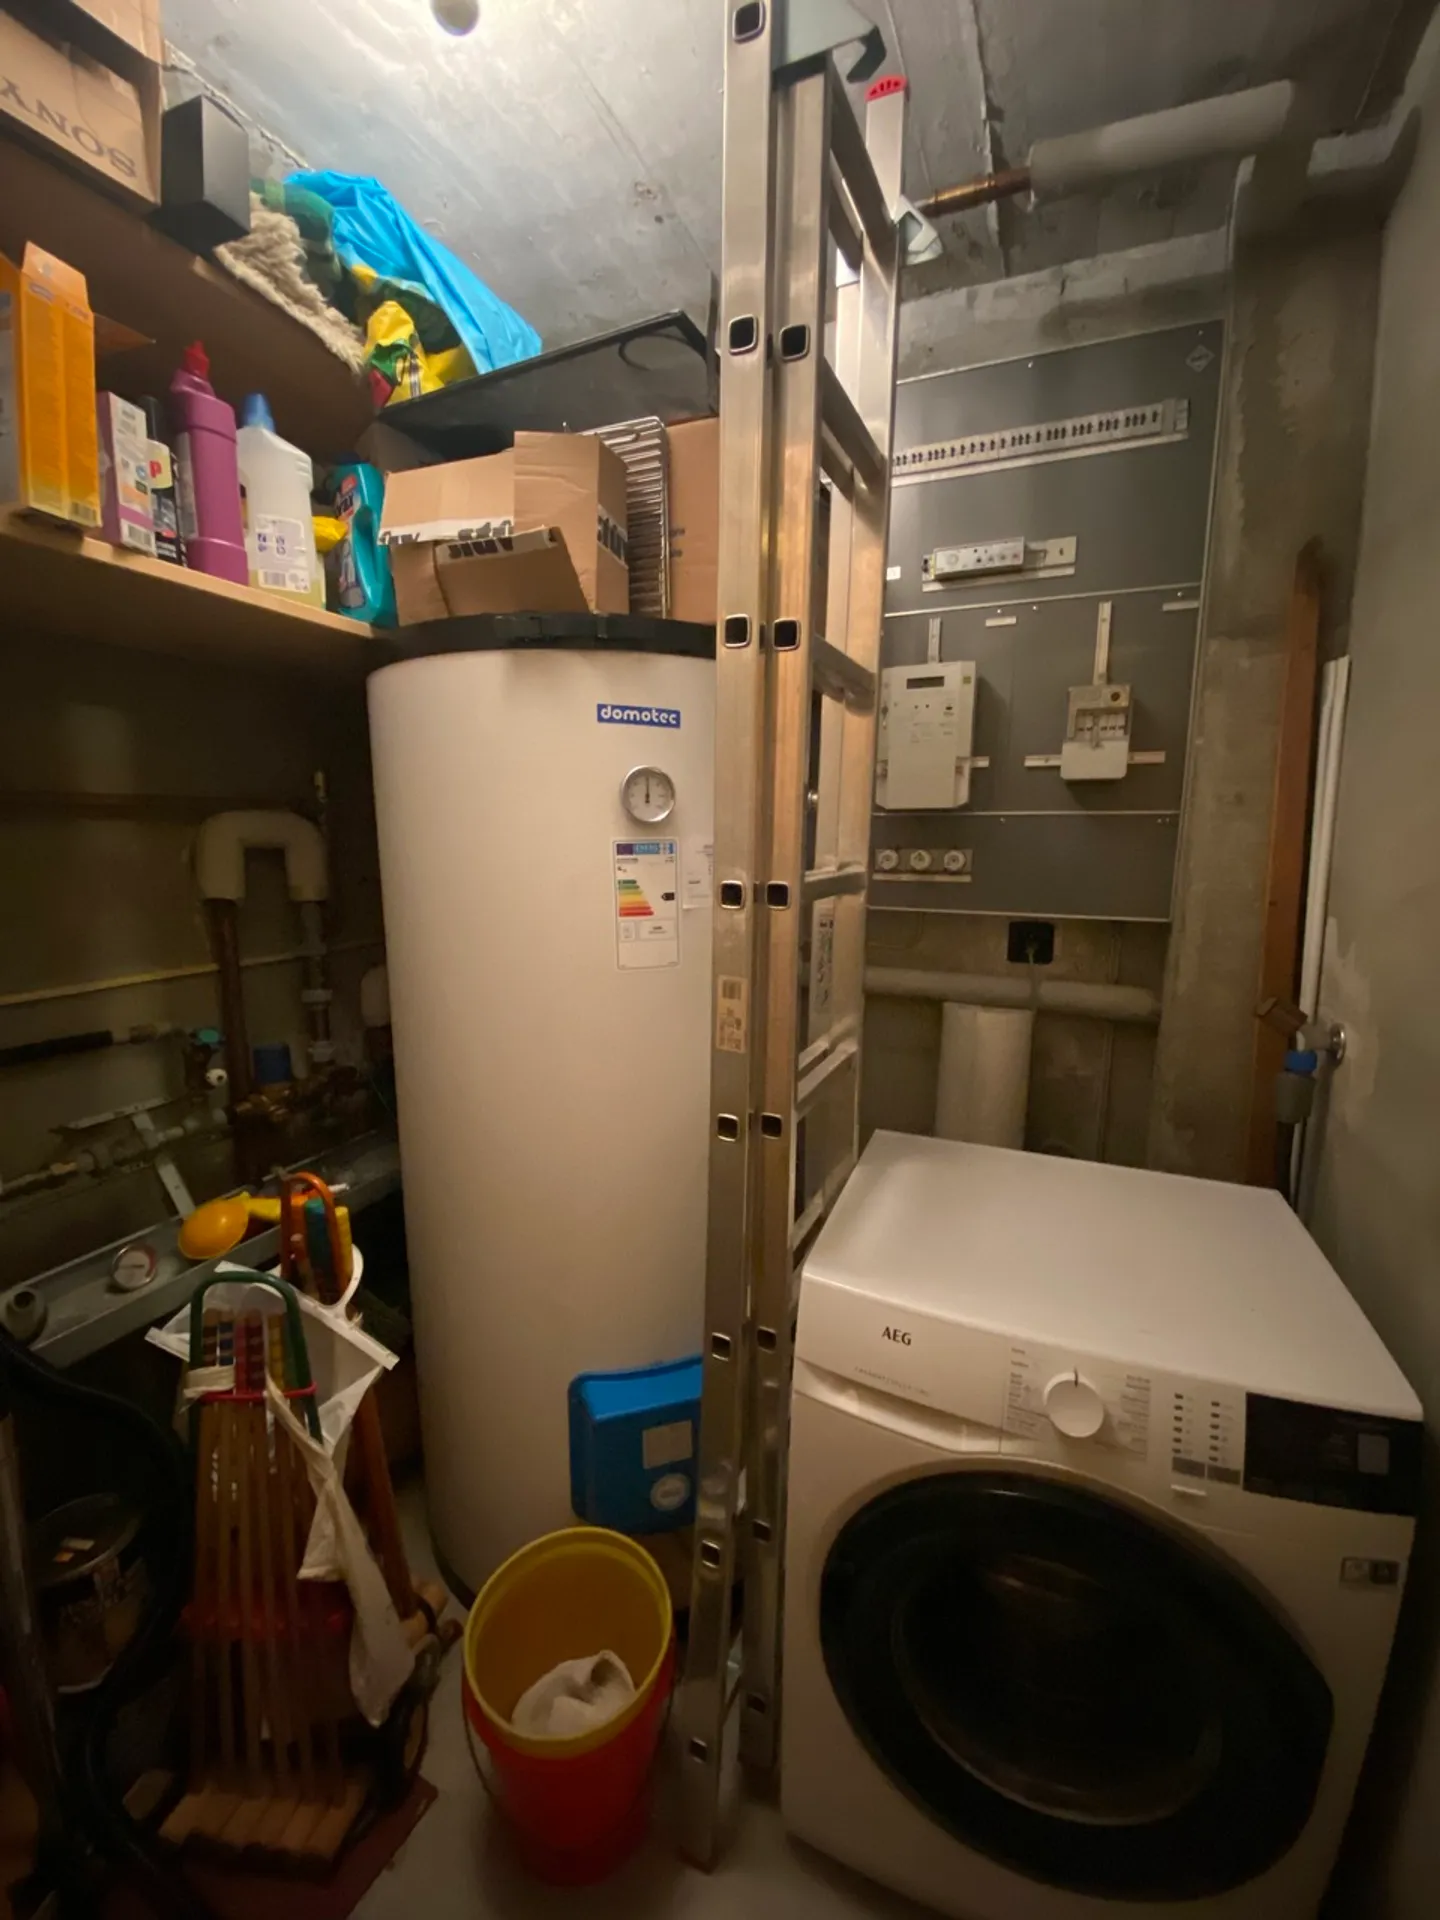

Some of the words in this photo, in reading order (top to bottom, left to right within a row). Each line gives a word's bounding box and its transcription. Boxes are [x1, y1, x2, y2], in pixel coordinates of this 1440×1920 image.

[0, 76, 137, 178] SONY
[600, 705, 678, 725] domotec
[881, 1326, 912, 1347] AEG
